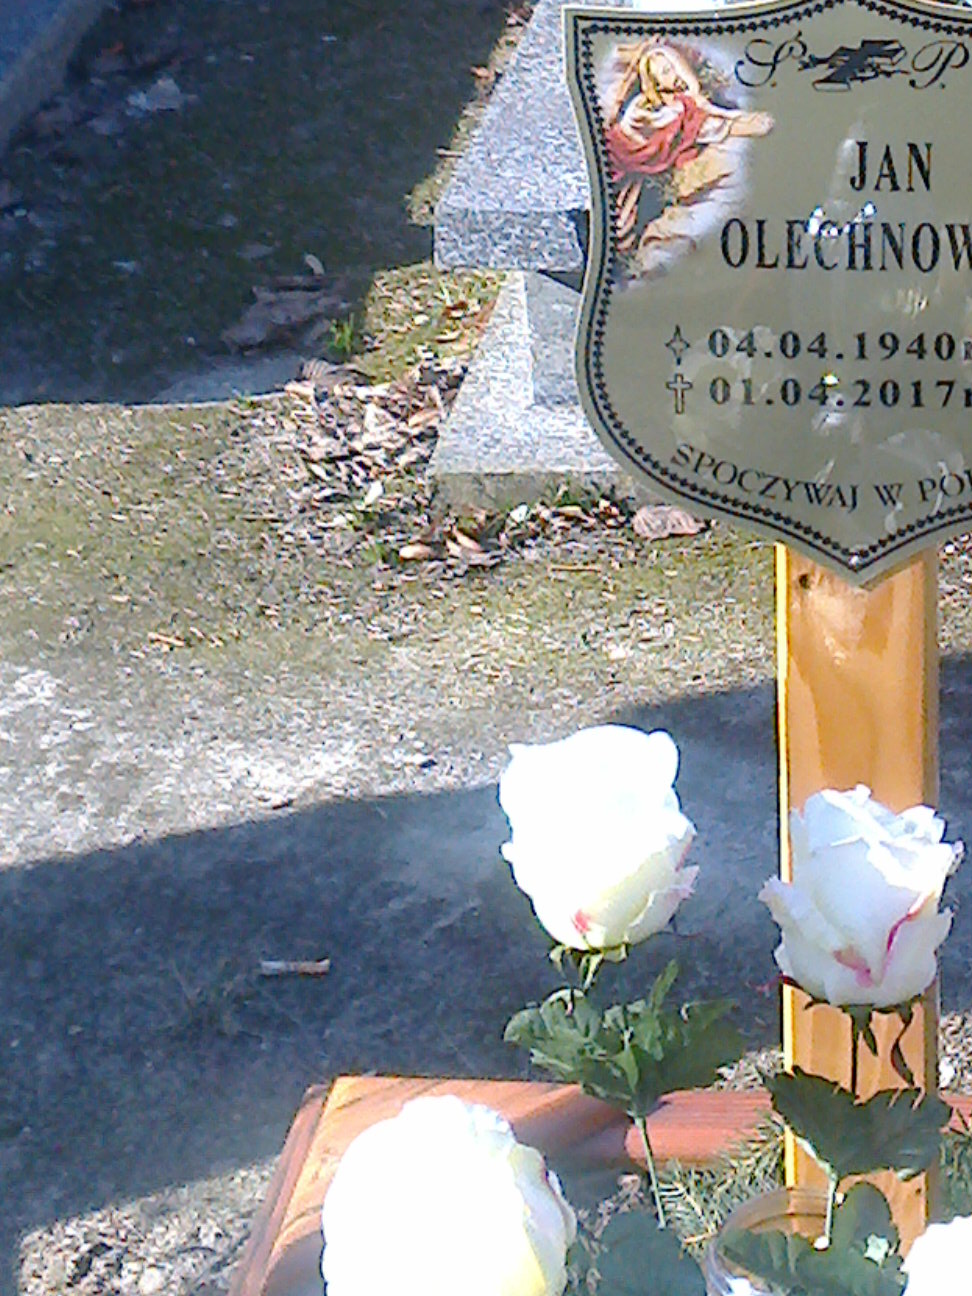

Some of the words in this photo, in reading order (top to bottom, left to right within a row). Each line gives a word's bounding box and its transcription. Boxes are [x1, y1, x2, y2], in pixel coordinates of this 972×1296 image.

[849, 141, 933, 192] JAN
[671, 442, 859, 514] SPOCZYWAJ
[874, 482, 903, 507] W
